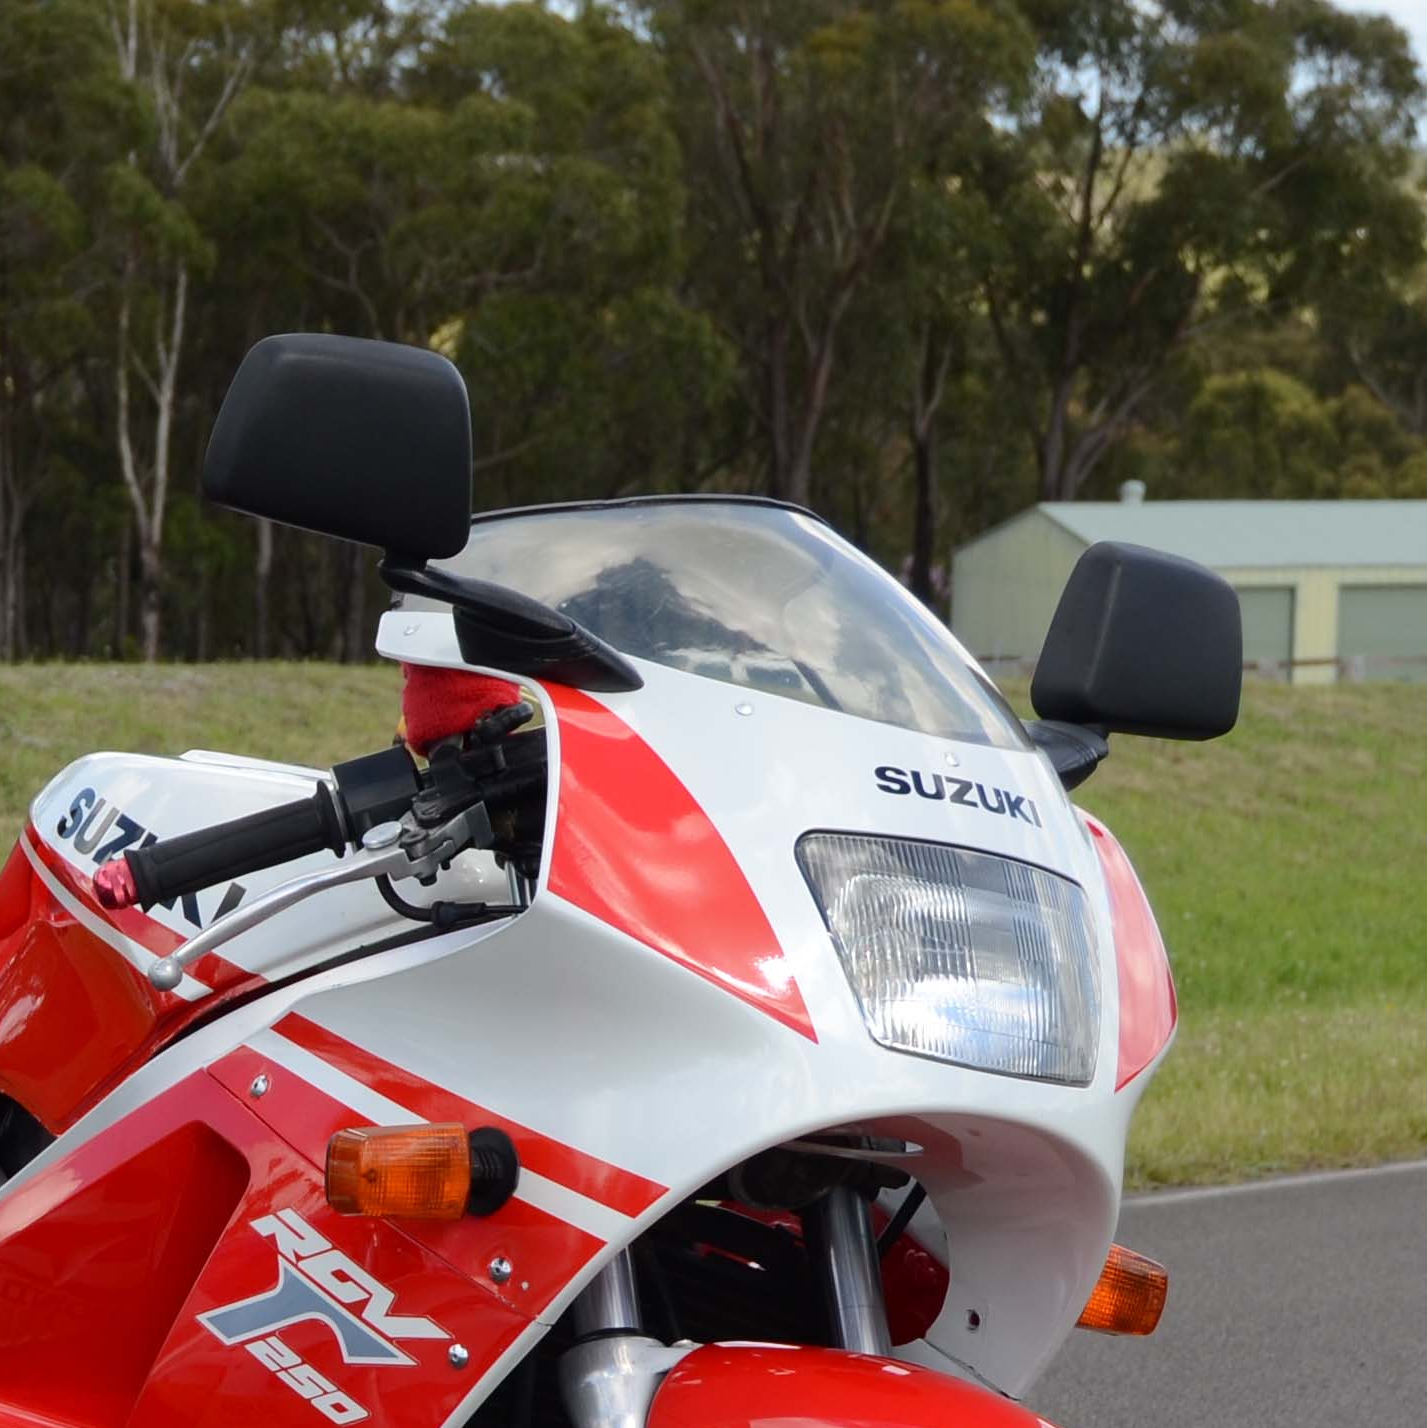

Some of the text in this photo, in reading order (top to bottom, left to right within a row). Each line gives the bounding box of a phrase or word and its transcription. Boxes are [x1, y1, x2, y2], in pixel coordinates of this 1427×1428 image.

[874, 766, 1043, 829] SUZUKI
[56, 787, 247, 930] SUZI
[249, 1207, 454, 1340] RGV
[243, 1334, 371, 1426] 250
